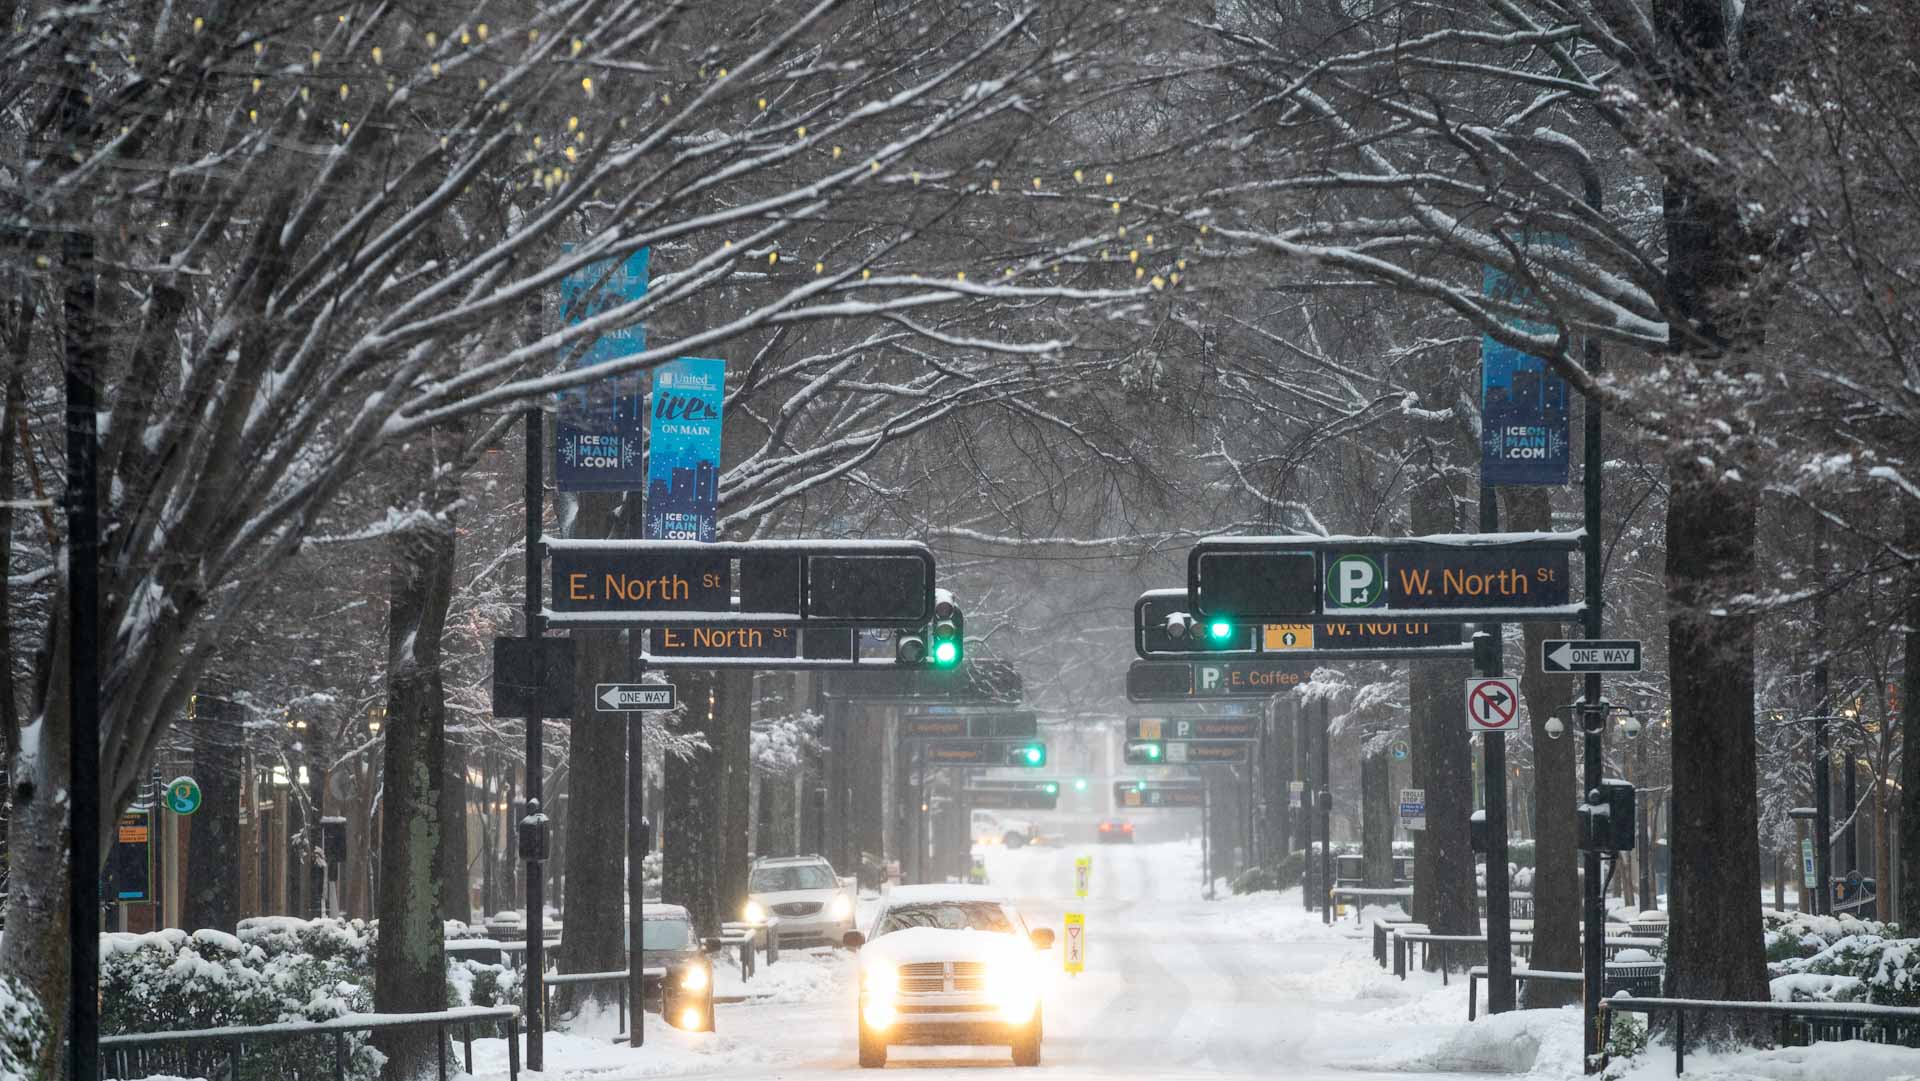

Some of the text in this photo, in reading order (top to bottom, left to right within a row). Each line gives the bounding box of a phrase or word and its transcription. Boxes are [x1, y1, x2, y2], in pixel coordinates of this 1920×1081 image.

[674, 373, 708, 384] United
[655, 391, 706, 420] ice
[662, 424, 710, 435] ON MAIN
[1507, 437, 1545, 447] MAIN
[580, 445, 618, 457] MAIN
[1506, 448, 1545, 459] .COM
[580, 457, 618, 468] .COM
[664, 521, 697, 531] MAIN
[664, 531, 697, 541] .COM
[570, 573, 721, 600] E. North St
[1400, 567, 1555, 596] W. North St
[1326, 624, 1429, 636] W. North
[664, 628, 789, 647] E. North St
[1572, 650, 1630, 662] ONE WAY
[1231, 671, 1245, 685] E.
[1249, 671, 1299, 685] Coffee
[620, 692, 666, 703] ONE WAY
